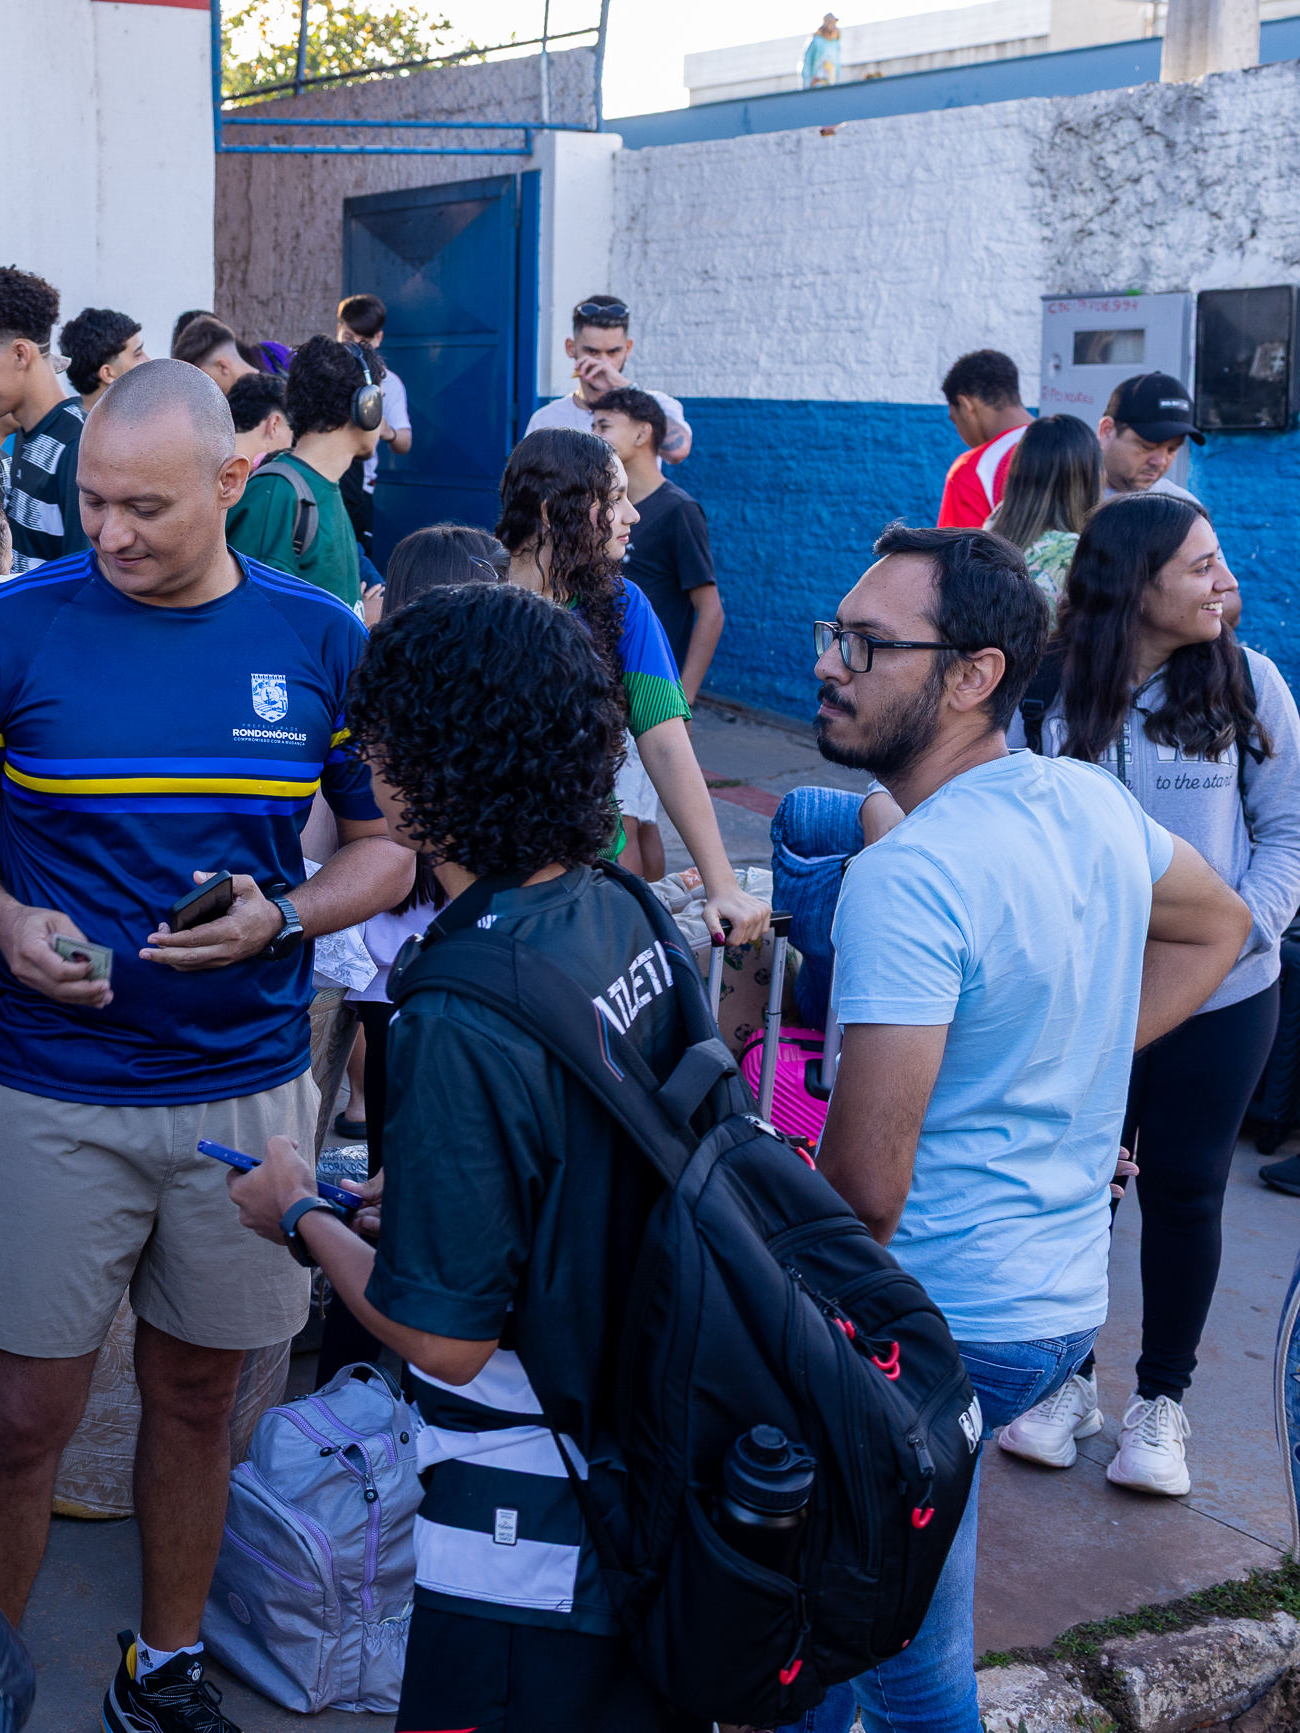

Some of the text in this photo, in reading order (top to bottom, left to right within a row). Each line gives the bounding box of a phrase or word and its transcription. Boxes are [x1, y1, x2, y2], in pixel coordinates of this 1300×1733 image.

[232, 729, 307, 741] RONDONÓPOLIS
[1156, 776, 1171, 790] to
[1174, 773, 1200, 790] the
